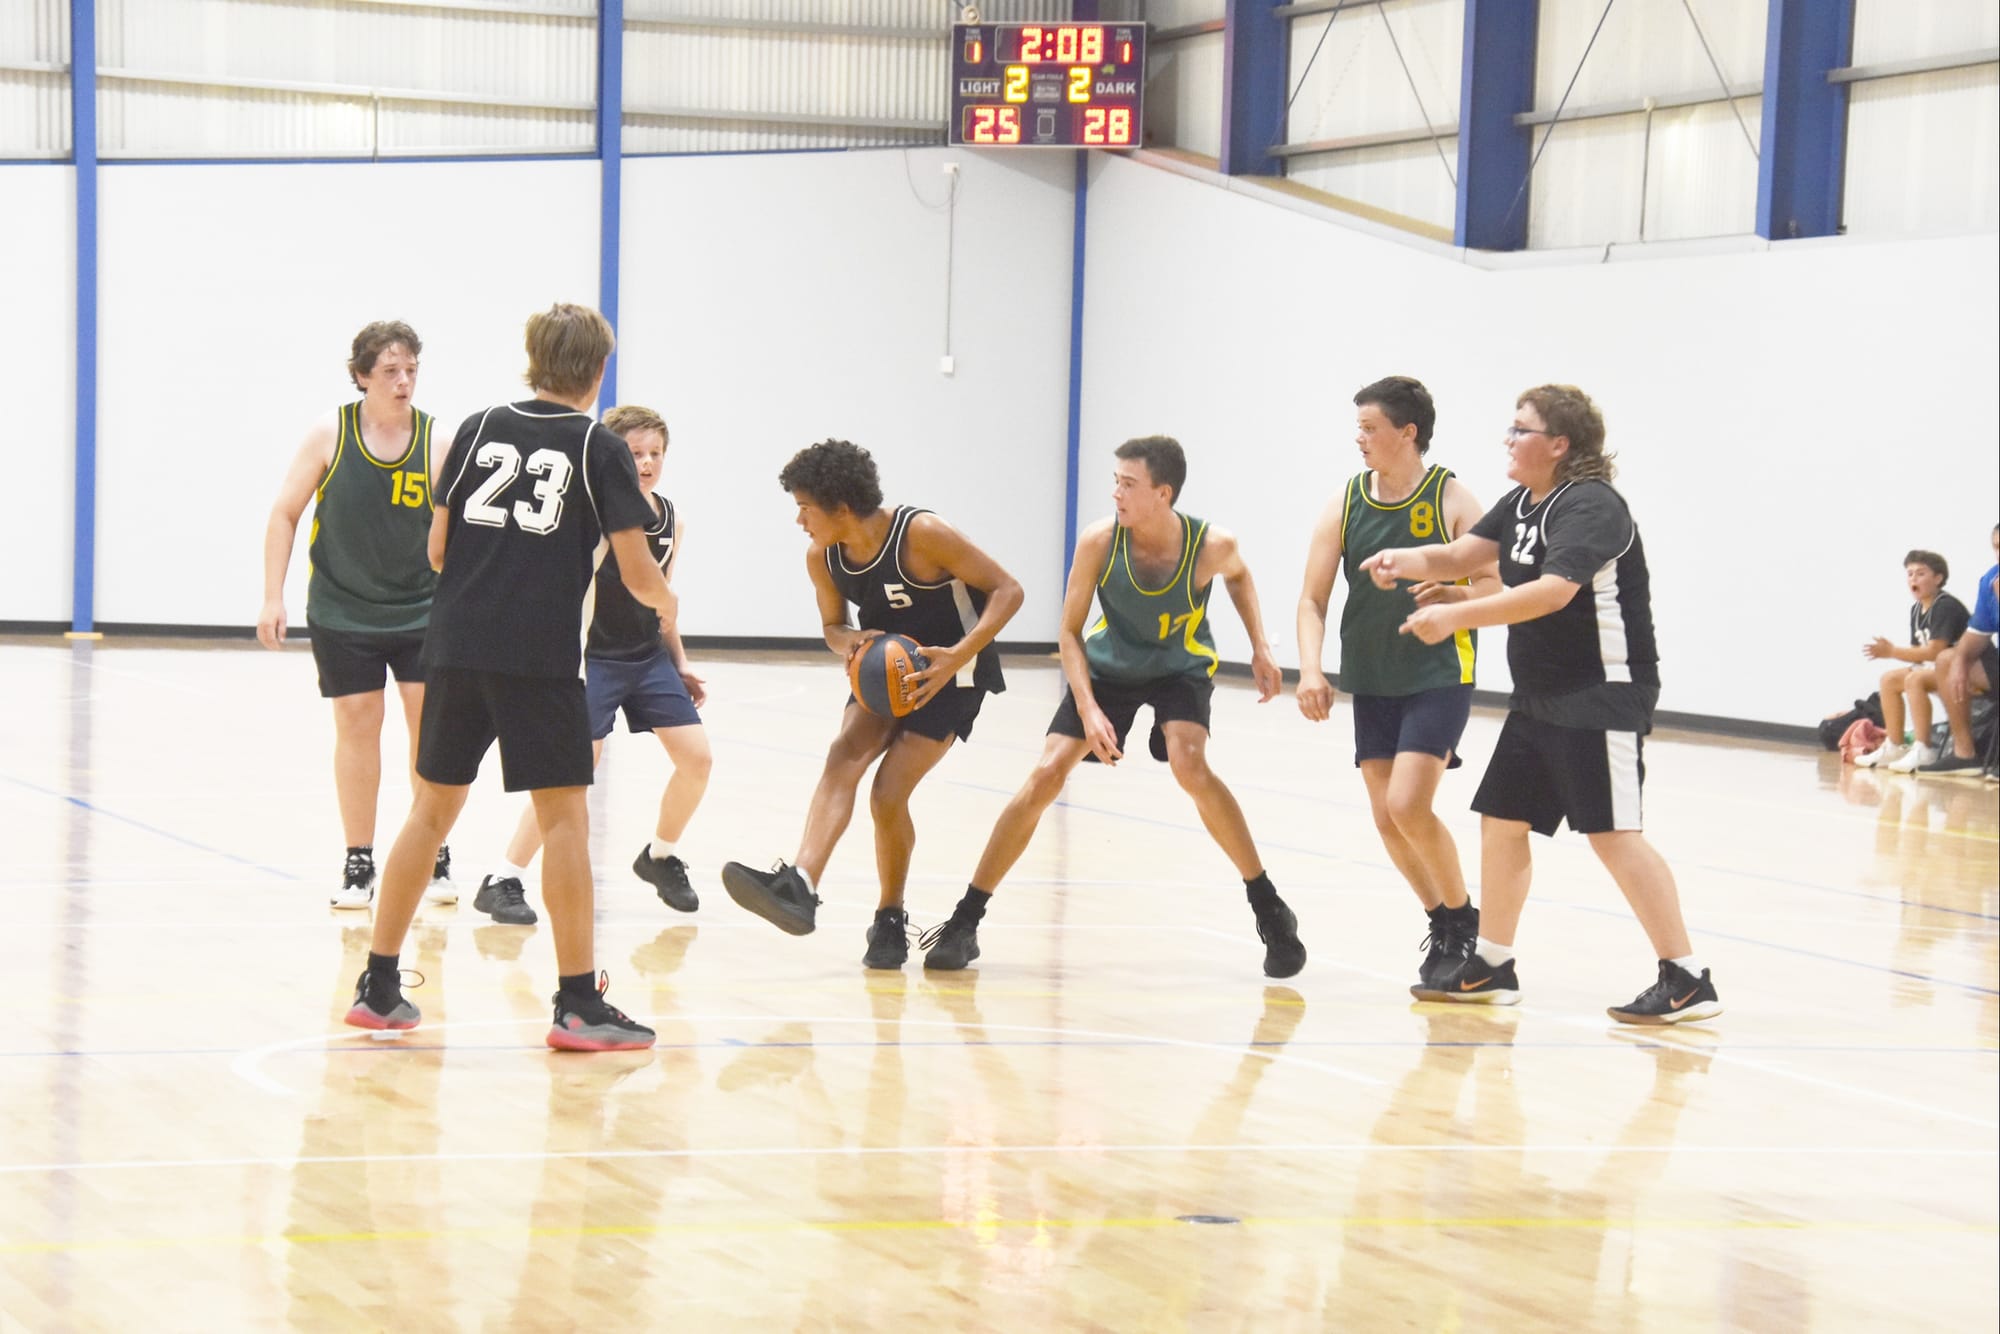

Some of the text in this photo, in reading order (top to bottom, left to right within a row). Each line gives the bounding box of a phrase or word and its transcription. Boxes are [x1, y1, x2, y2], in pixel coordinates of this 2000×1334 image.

[974, 42, 982, 63] 1
[1021, 27, 1103, 63] 2:08
[1123, 42, 1130, 63] 1
[960, 81, 1000, 93] LIGHT
[1006, 67, 1028, 102] 2
[1069, 67, 1091, 103] 2
[1095, 82, 1136, 94] DARK
[974, 108, 1020, 143] 25
[1084, 108, 1130, 143] 28
[391, 470, 427, 508] 15
[463, 441, 573, 535] 23
[1409, 501, 1434, 538] 8
[658, 537, 674, 568] 7
[1510, 523, 1538, 565] 22
[884, 583, 913, 609] 5
